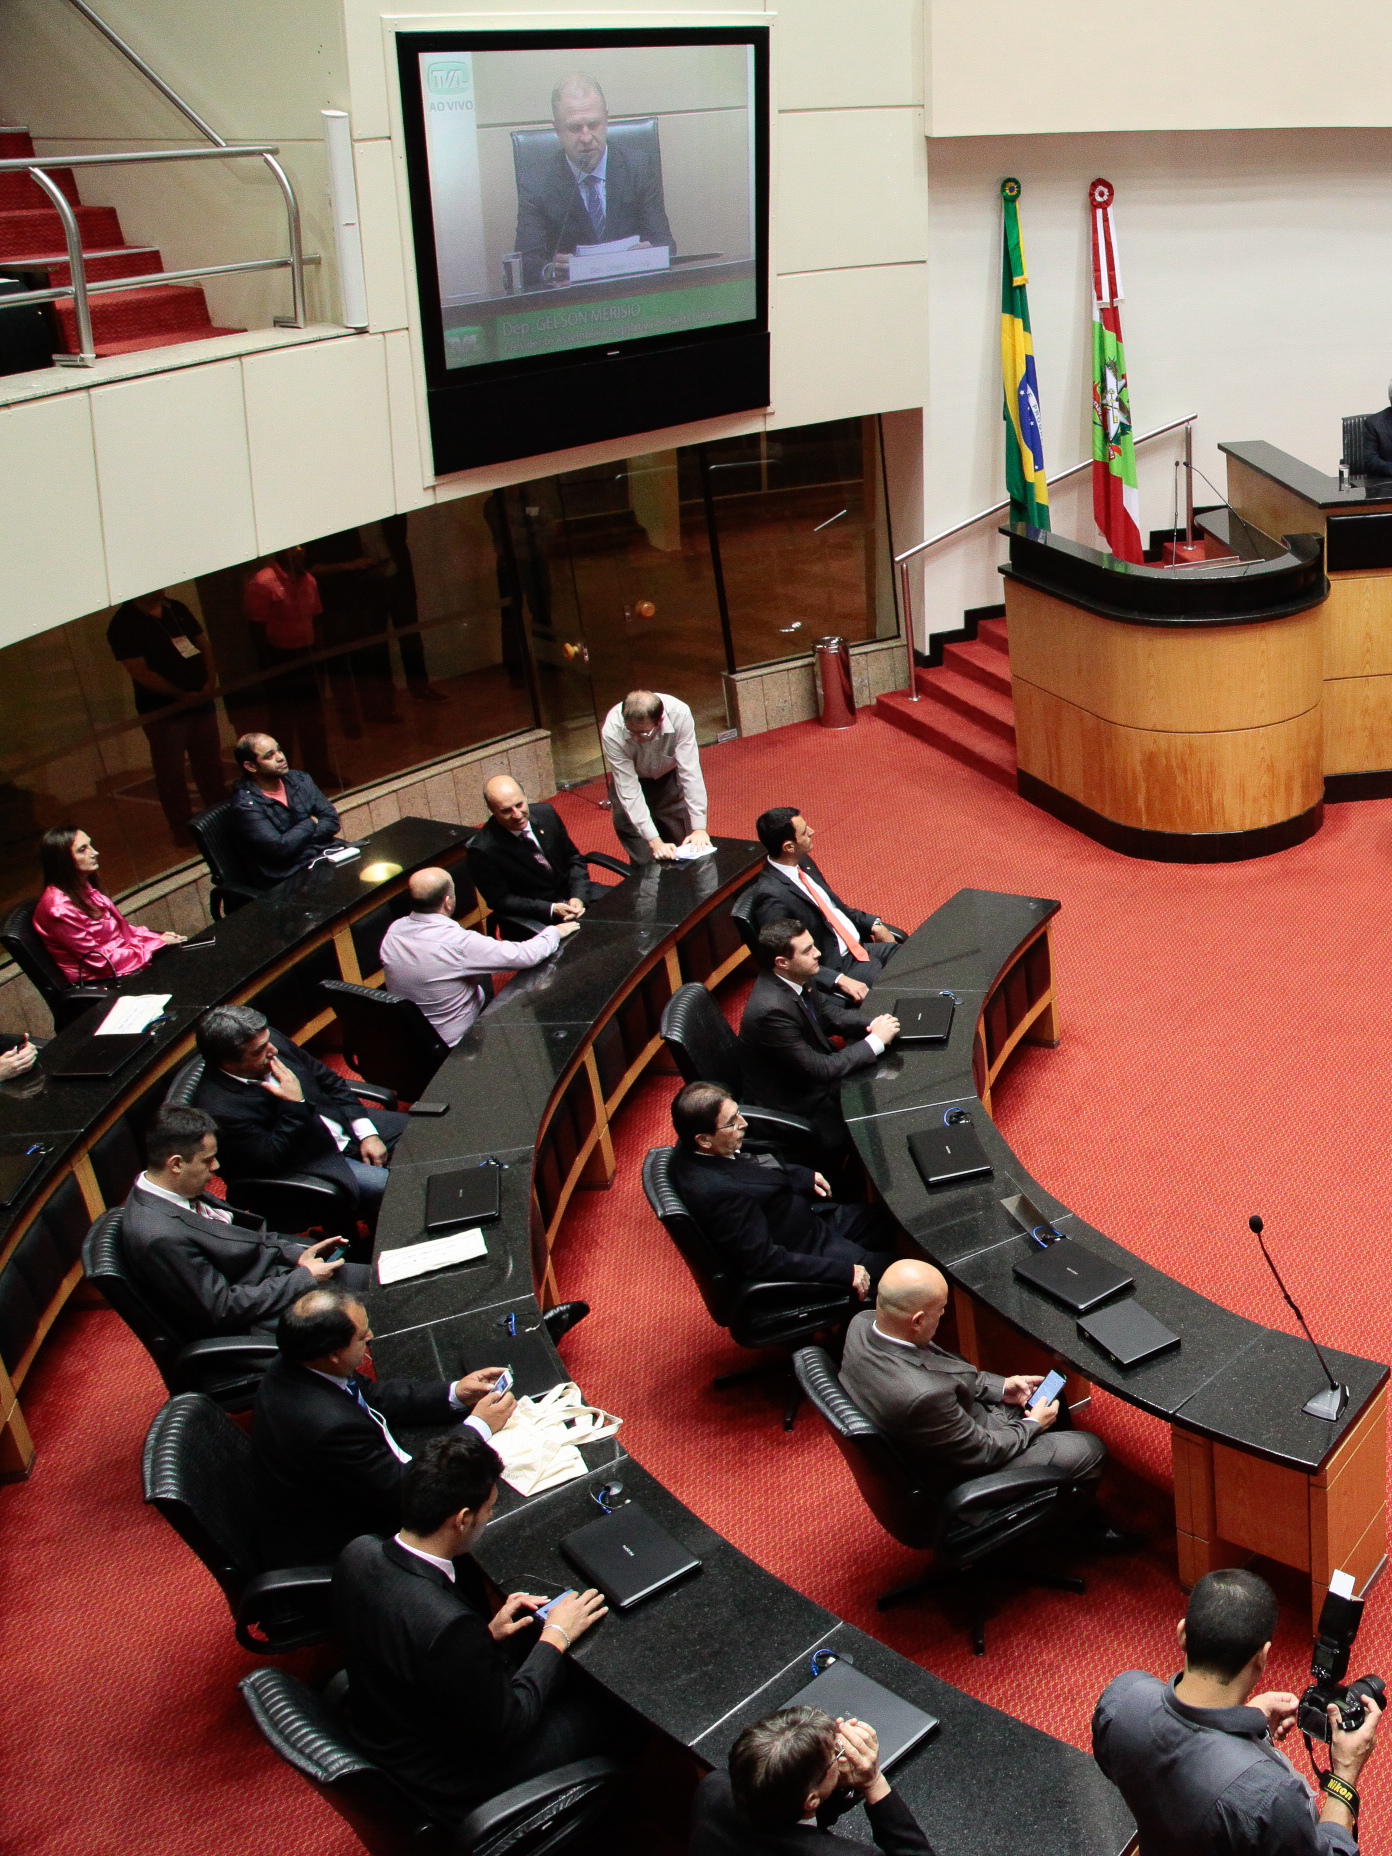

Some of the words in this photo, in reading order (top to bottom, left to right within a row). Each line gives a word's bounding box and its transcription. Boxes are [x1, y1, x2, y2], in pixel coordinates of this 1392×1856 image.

[430, 102, 445, 112] AO
[447, 100, 474, 111] VIVO
[537, 310, 588, 331] GELSON
[591, 303, 641, 322] MERISIO
[1327, 1778, 1353, 1801] Nikon
